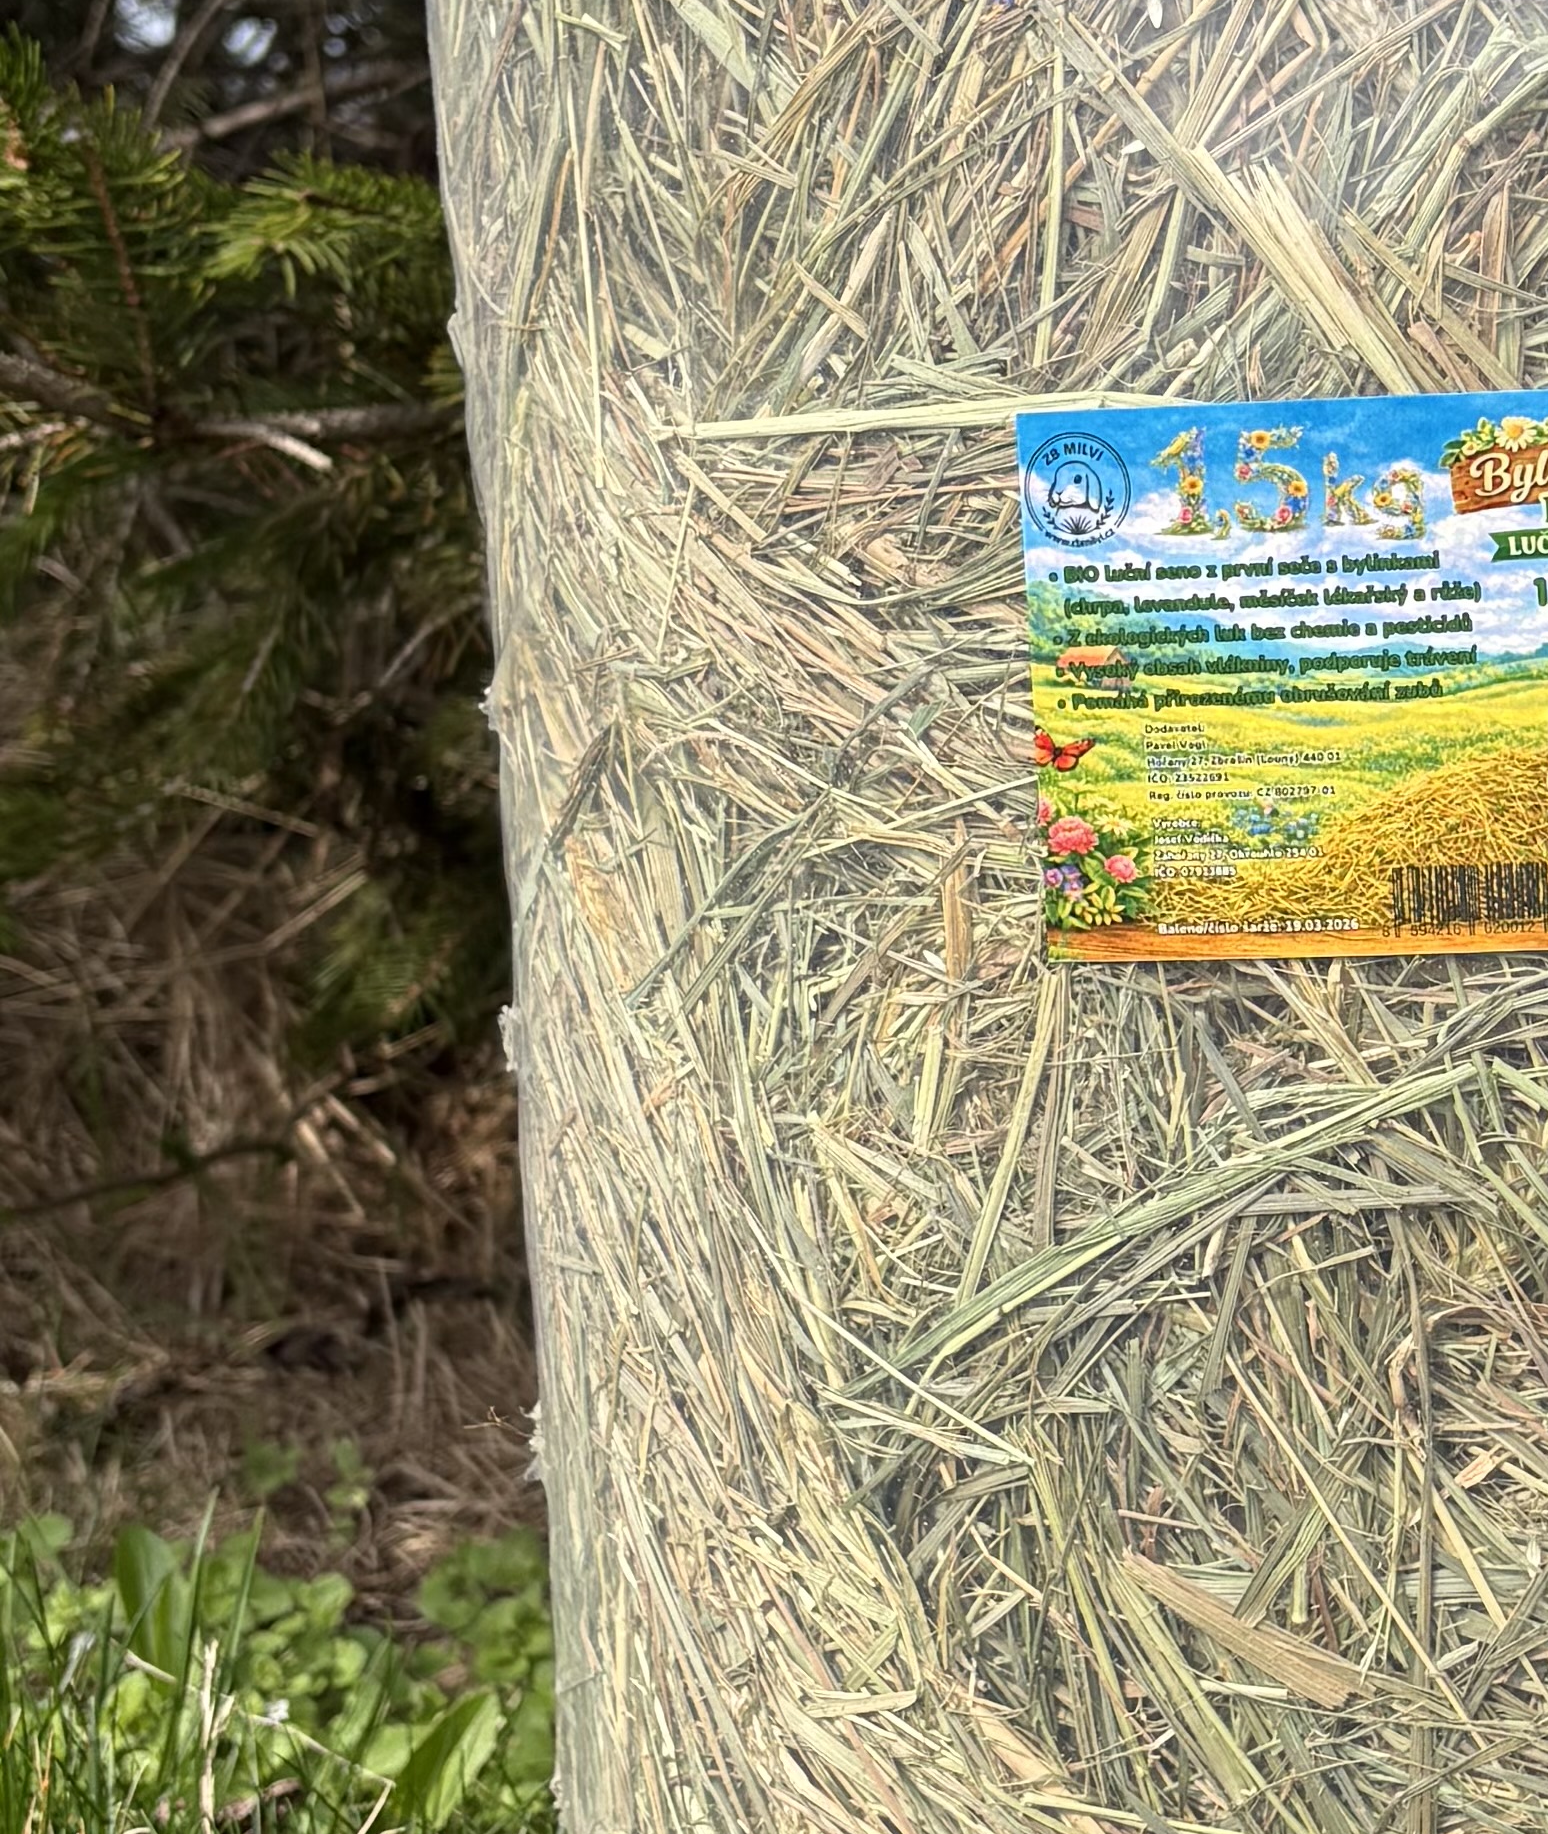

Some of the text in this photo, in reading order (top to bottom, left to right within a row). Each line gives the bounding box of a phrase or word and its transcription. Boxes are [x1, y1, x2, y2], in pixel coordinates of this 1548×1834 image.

[1042, 441, 1104, 466] ZB MILVI
[1063, 565, 1100, 583] BIO
[1104, 561, 1152, 582] luční
[1155, 565, 1202, 581] seno
[1205, 564, 1218, 578] z
[1221, 556, 1273, 581] první
[1326, 559, 1338, 574] s
[1342, 550, 1440, 576] bylinkami
[1064, 597, 1130, 619] (chrpa,
[1240, 588, 1319, 609] měsíček
[1324, 583, 1408, 606] lékařský
[1414, 588, 1426, 602] a
[1066, 612, 1473, 649] Z ekologických luk bez chemie a pesticidů
[1069, 645, 1477, 681] Vysoký obsah vlákniny, podporuje trávení
[1072, 678, 1443, 711] Pomáhá přirozenému obrušování zubů
[1145, 740, 1176, 750] Pavel
[1327, 751, 1341, 762] 01
[1157, 921, 1239, 936] Baleno/číslo
[1285, 917, 1360, 932] 19.03.2026
